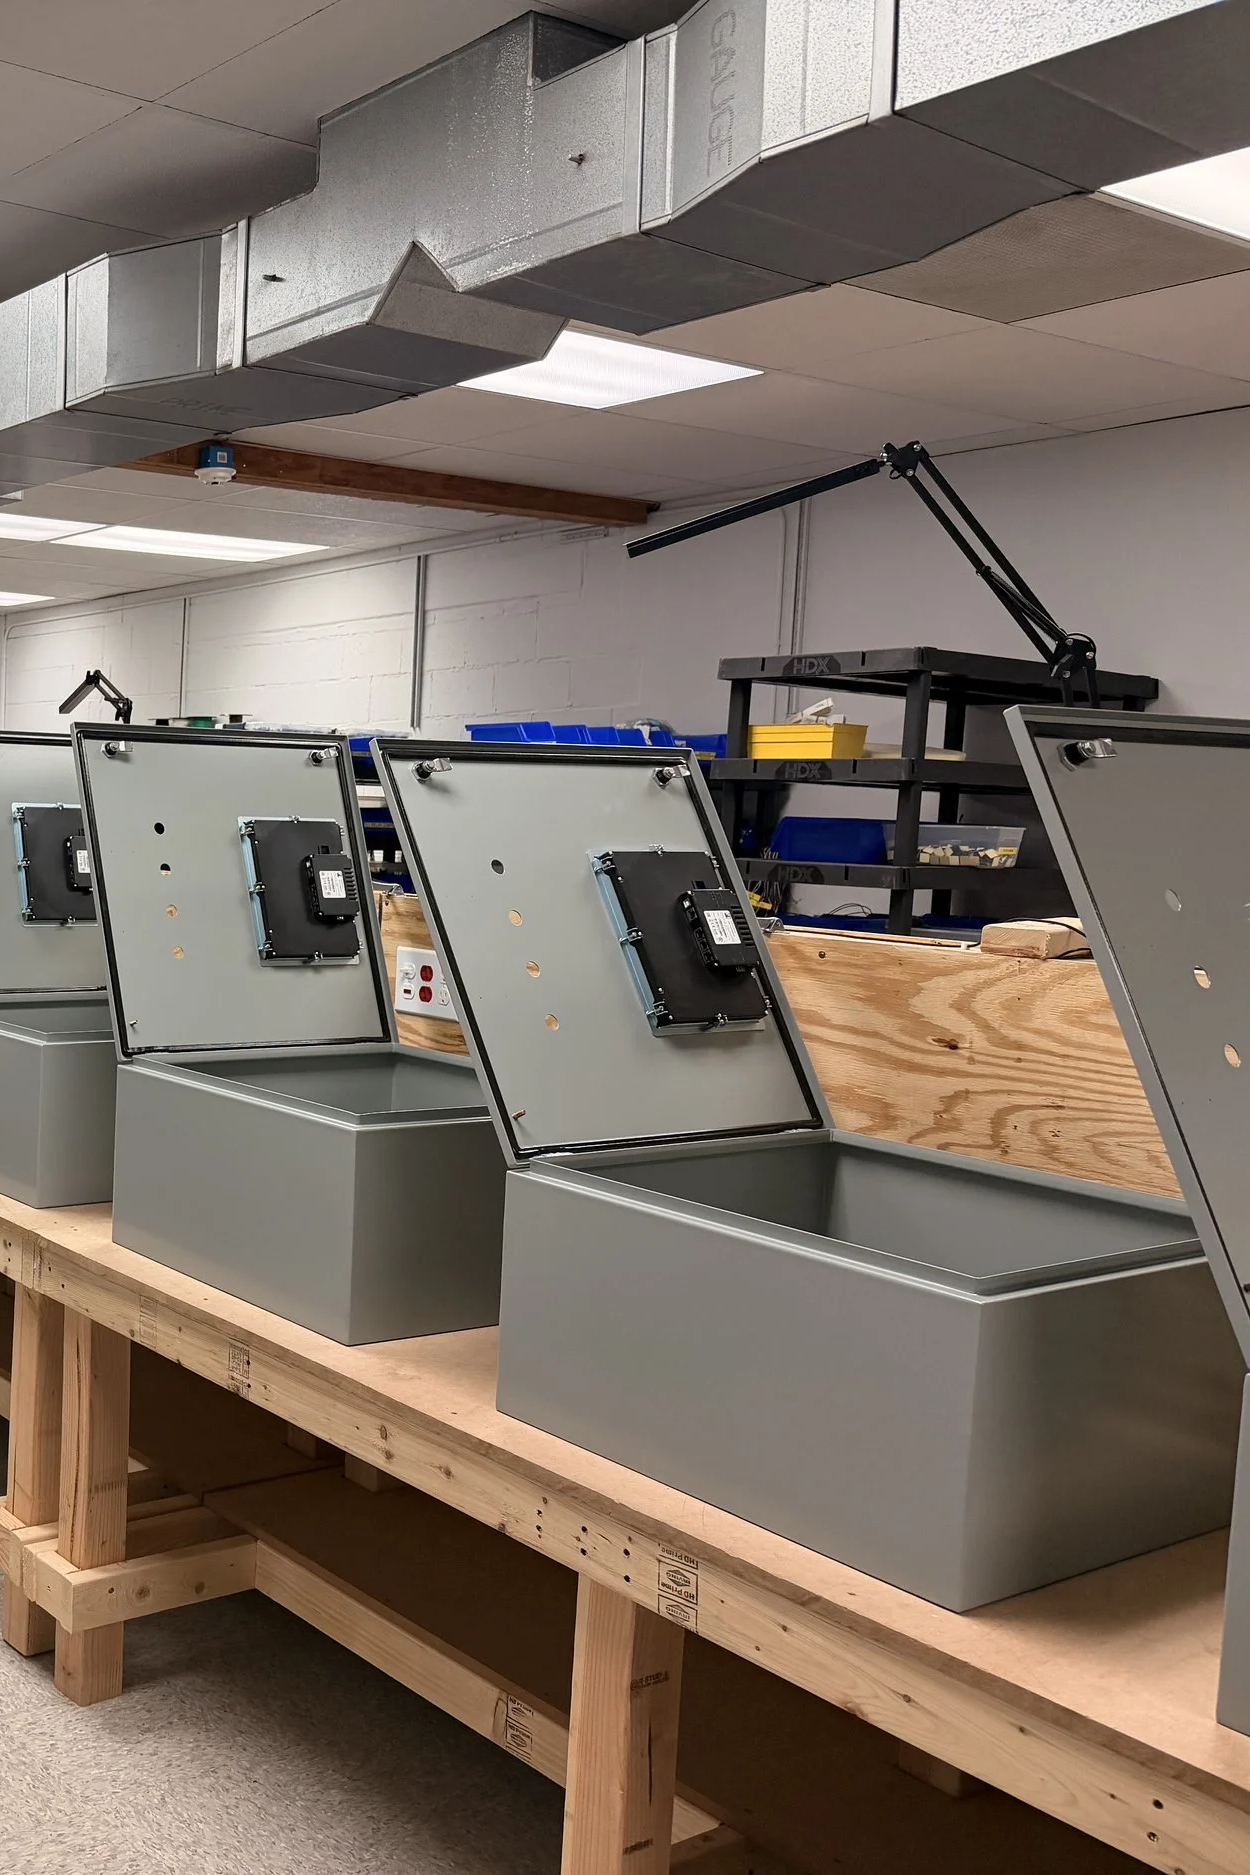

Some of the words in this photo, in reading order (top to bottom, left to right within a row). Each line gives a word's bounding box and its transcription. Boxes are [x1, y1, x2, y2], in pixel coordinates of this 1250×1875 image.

[707, 9, 736, 177] GAUGE
[793, 656, 830, 675] HDX
[785, 760, 822, 780] HDX
[660, 1582, 683, 1596] Prime
